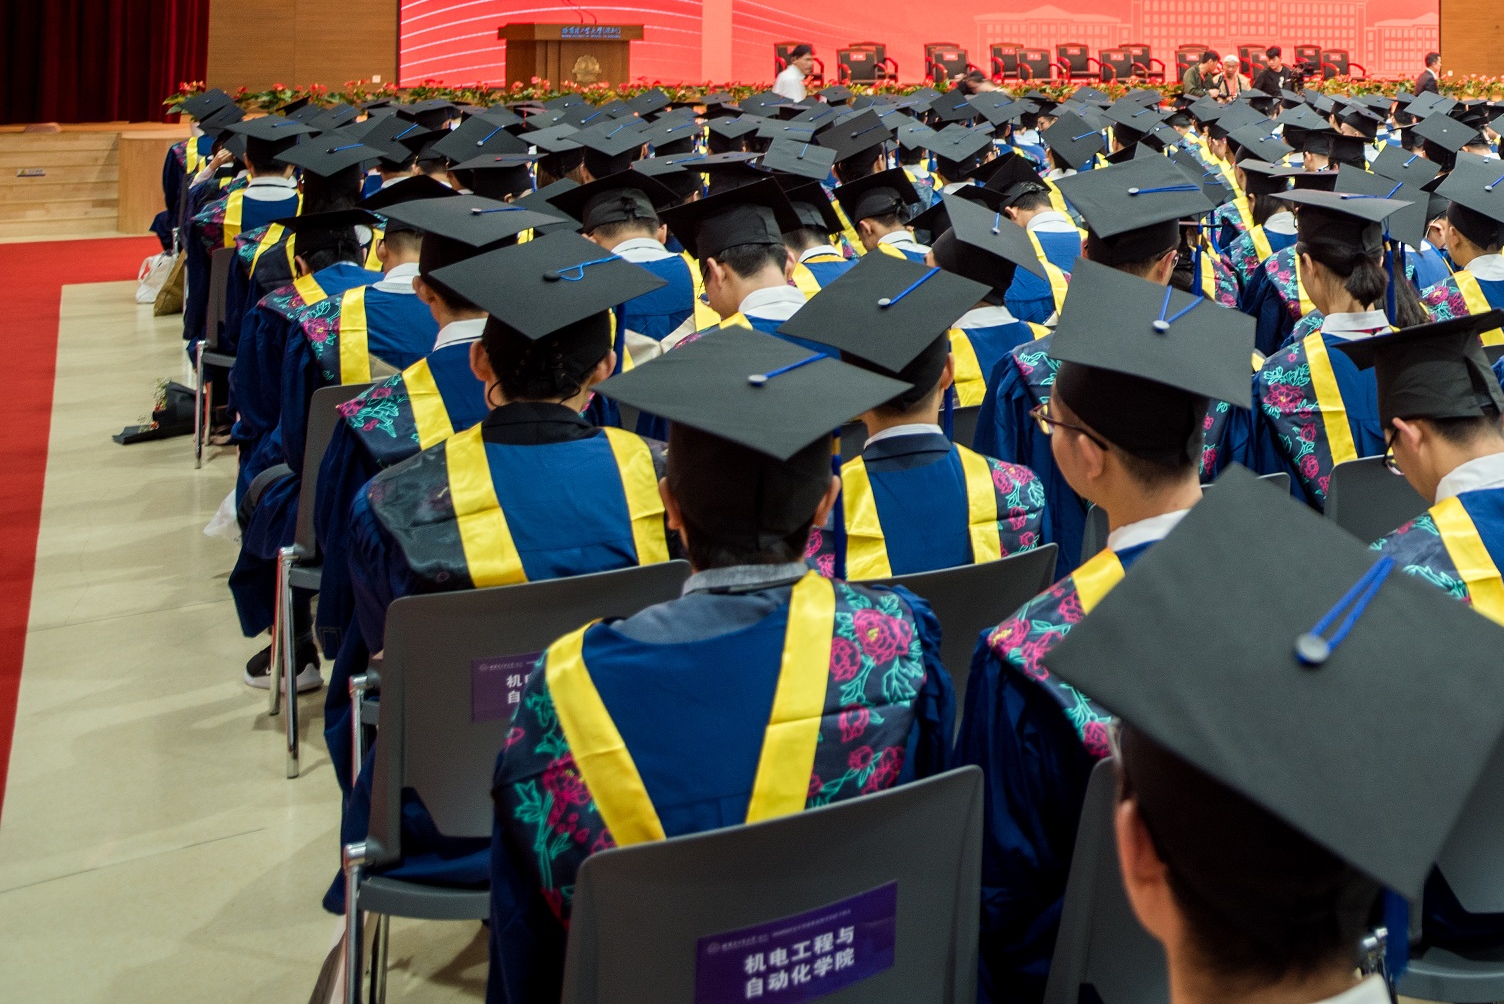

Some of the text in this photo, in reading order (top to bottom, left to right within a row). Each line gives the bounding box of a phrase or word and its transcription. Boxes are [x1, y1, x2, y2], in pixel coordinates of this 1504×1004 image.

[744, 925, 855, 975] 机电工程与
[745, 947, 855, 1000] 自动化学院
